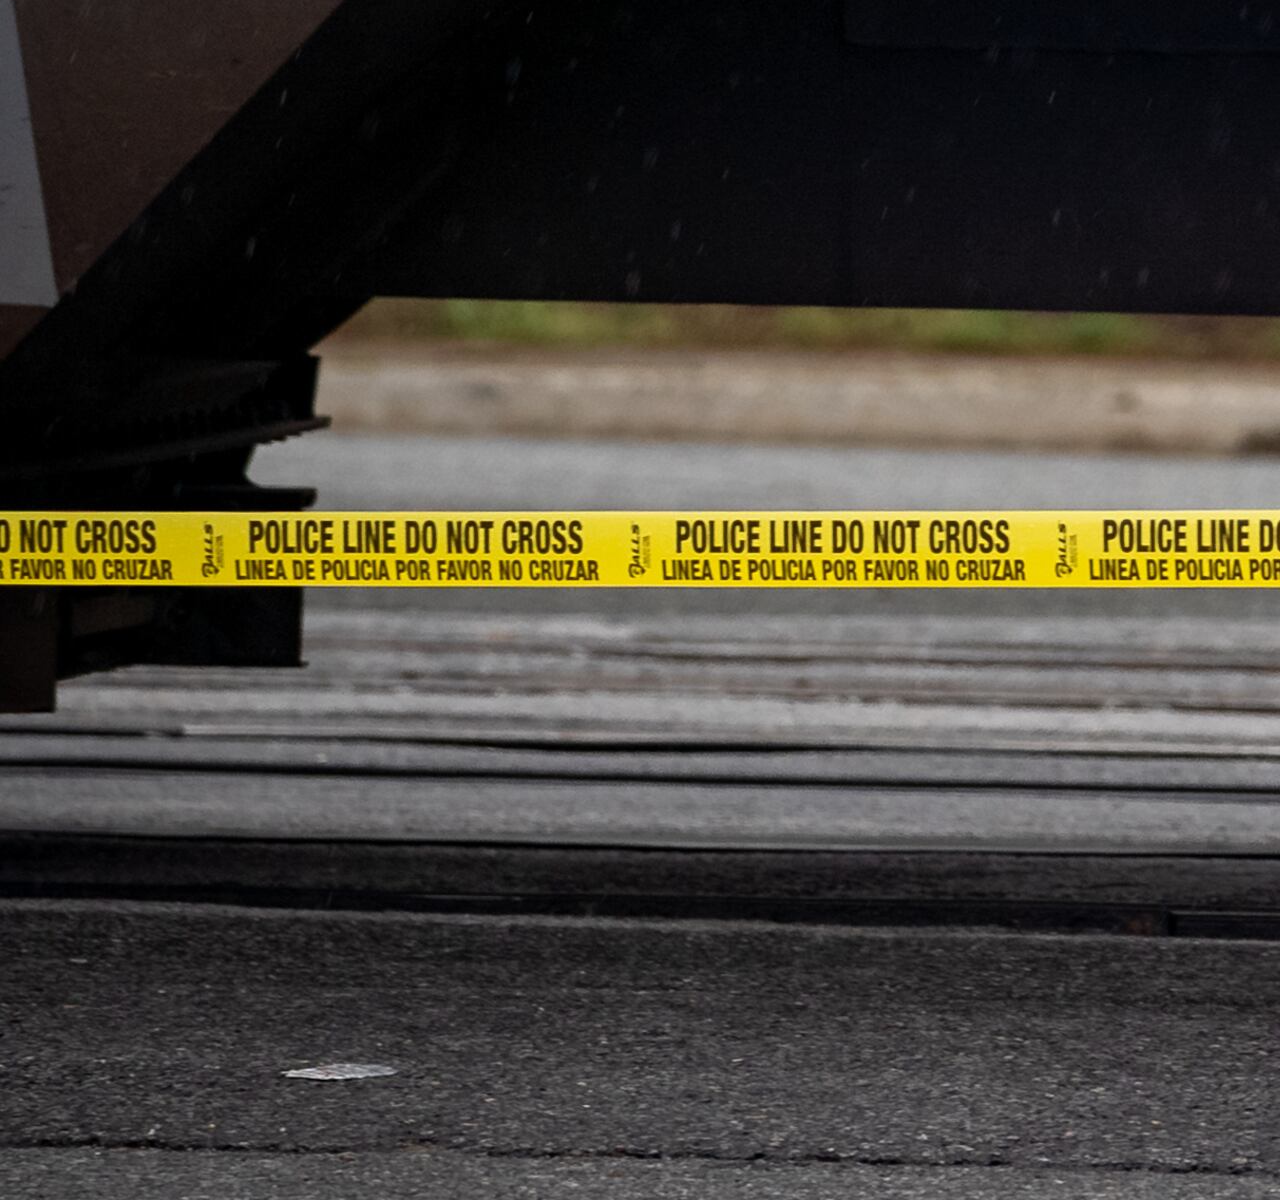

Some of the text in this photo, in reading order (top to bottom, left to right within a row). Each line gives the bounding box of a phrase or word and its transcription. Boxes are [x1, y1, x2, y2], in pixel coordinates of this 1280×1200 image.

[0, 519, 157, 554] O NOT CROSS
[248, 519, 334, 555] POLICE
[342, 520, 397, 554] LINE
[404, 519, 438, 555] DO
[446, 520, 495, 555] NOT
[501, 519, 584, 555] CROSS
[675, 519, 761, 554] POLICE
[769, 520, 823, 554] LINE
[831, 519, 865, 555] DO
[873, 519, 921, 555] NOT
[928, 519, 1010, 555] CROSS
[1103, 518, 1188, 554] POLICE
[1196, 519, 1250, 553] LINE
[9, 558, 67, 580] FAVOR
[71, 558, 97, 580] NO
[102, 558, 173, 581] CRUZAR
[234, 558, 599, 582] LINEA DE POLICIA POR FAVOR NO CRUZAR
[661, 558, 1026, 582] LINEA DE POLICIA POR FAVOR NO CRUZAR
[1088, 558, 1141, 581] LINEA
[1146, 558, 1169, 581] DE
[1174, 558, 1244, 581] POLICIA
